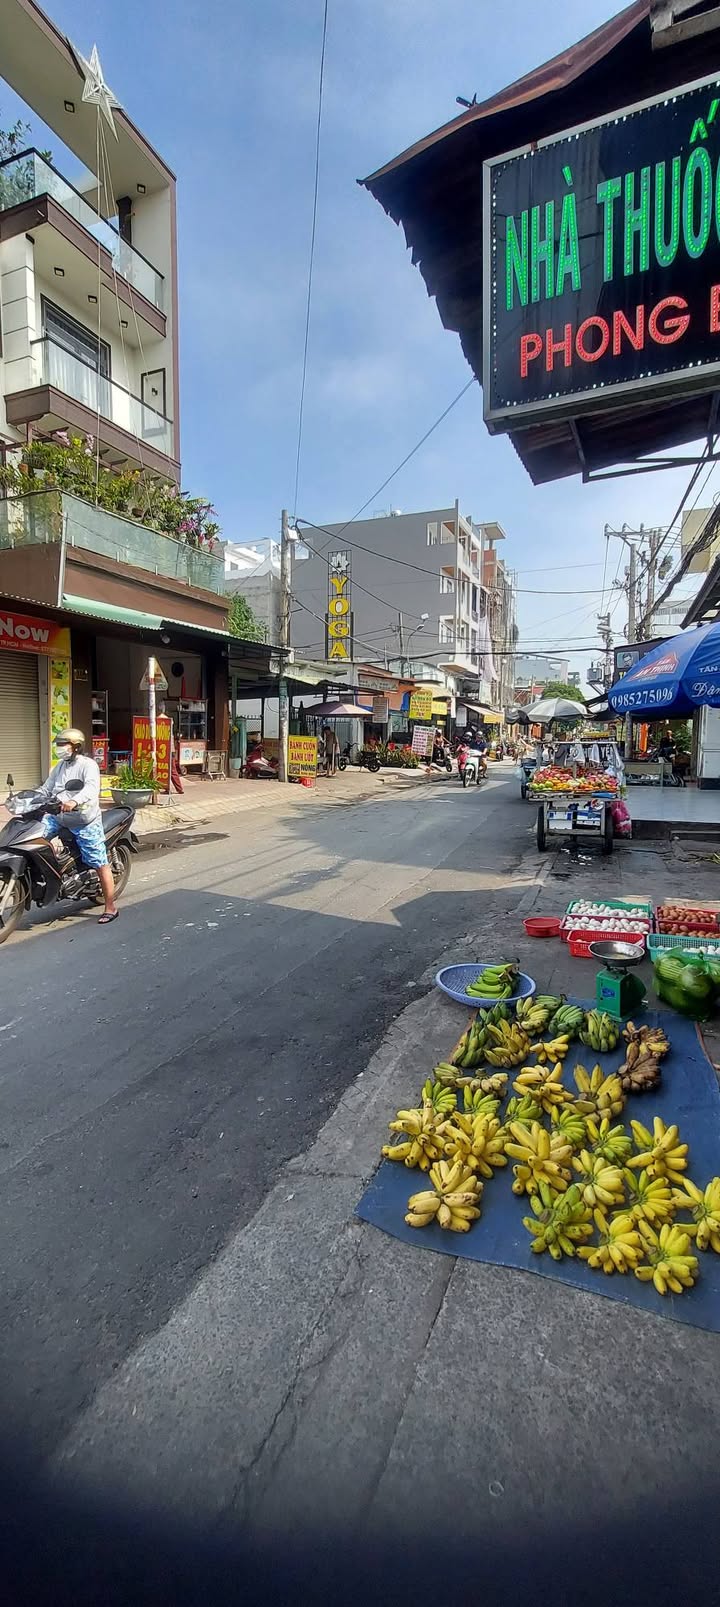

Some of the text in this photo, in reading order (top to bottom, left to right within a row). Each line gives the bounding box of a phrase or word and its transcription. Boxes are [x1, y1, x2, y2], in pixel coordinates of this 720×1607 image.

[505, 99, 720, 310] NHÀ THUỐ
[520, 295, 691, 378] PHONG
[328, 576, 350, 659] YOGA
[611, 687, 673, 708] 0985275096
